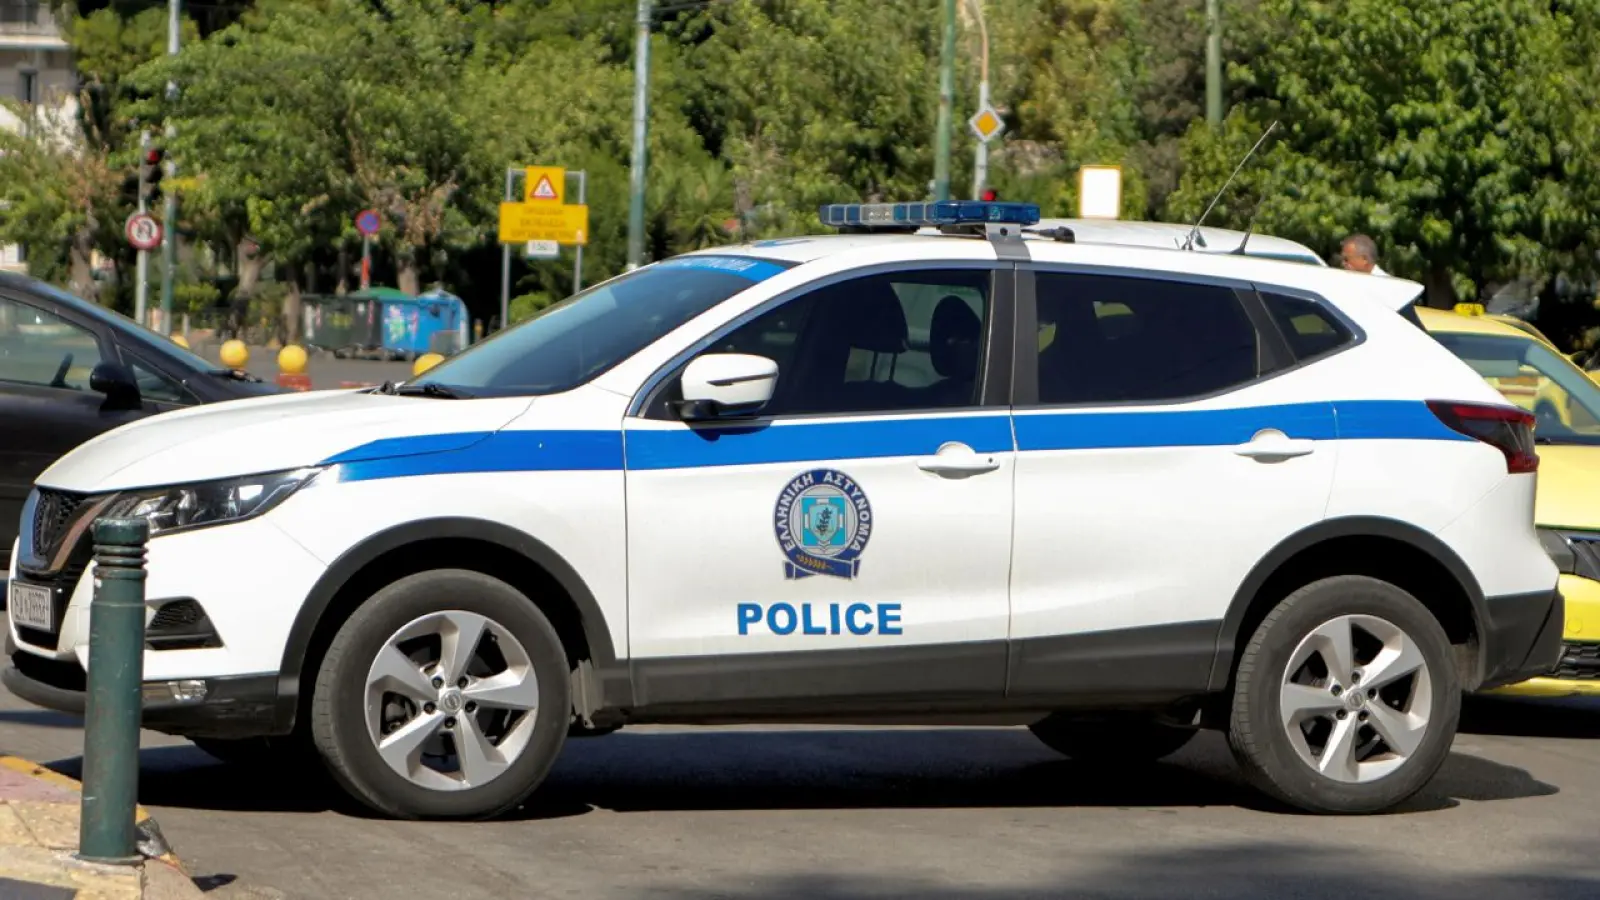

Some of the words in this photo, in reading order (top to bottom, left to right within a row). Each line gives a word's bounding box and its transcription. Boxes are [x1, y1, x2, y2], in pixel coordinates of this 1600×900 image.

[777, 473, 815, 551] ΕΛΛΗΝΙΚΗ
[822, 471, 870, 551] ΑΣΤΥΝΟΜΙΑ
[737, 602, 903, 635] POLICE
